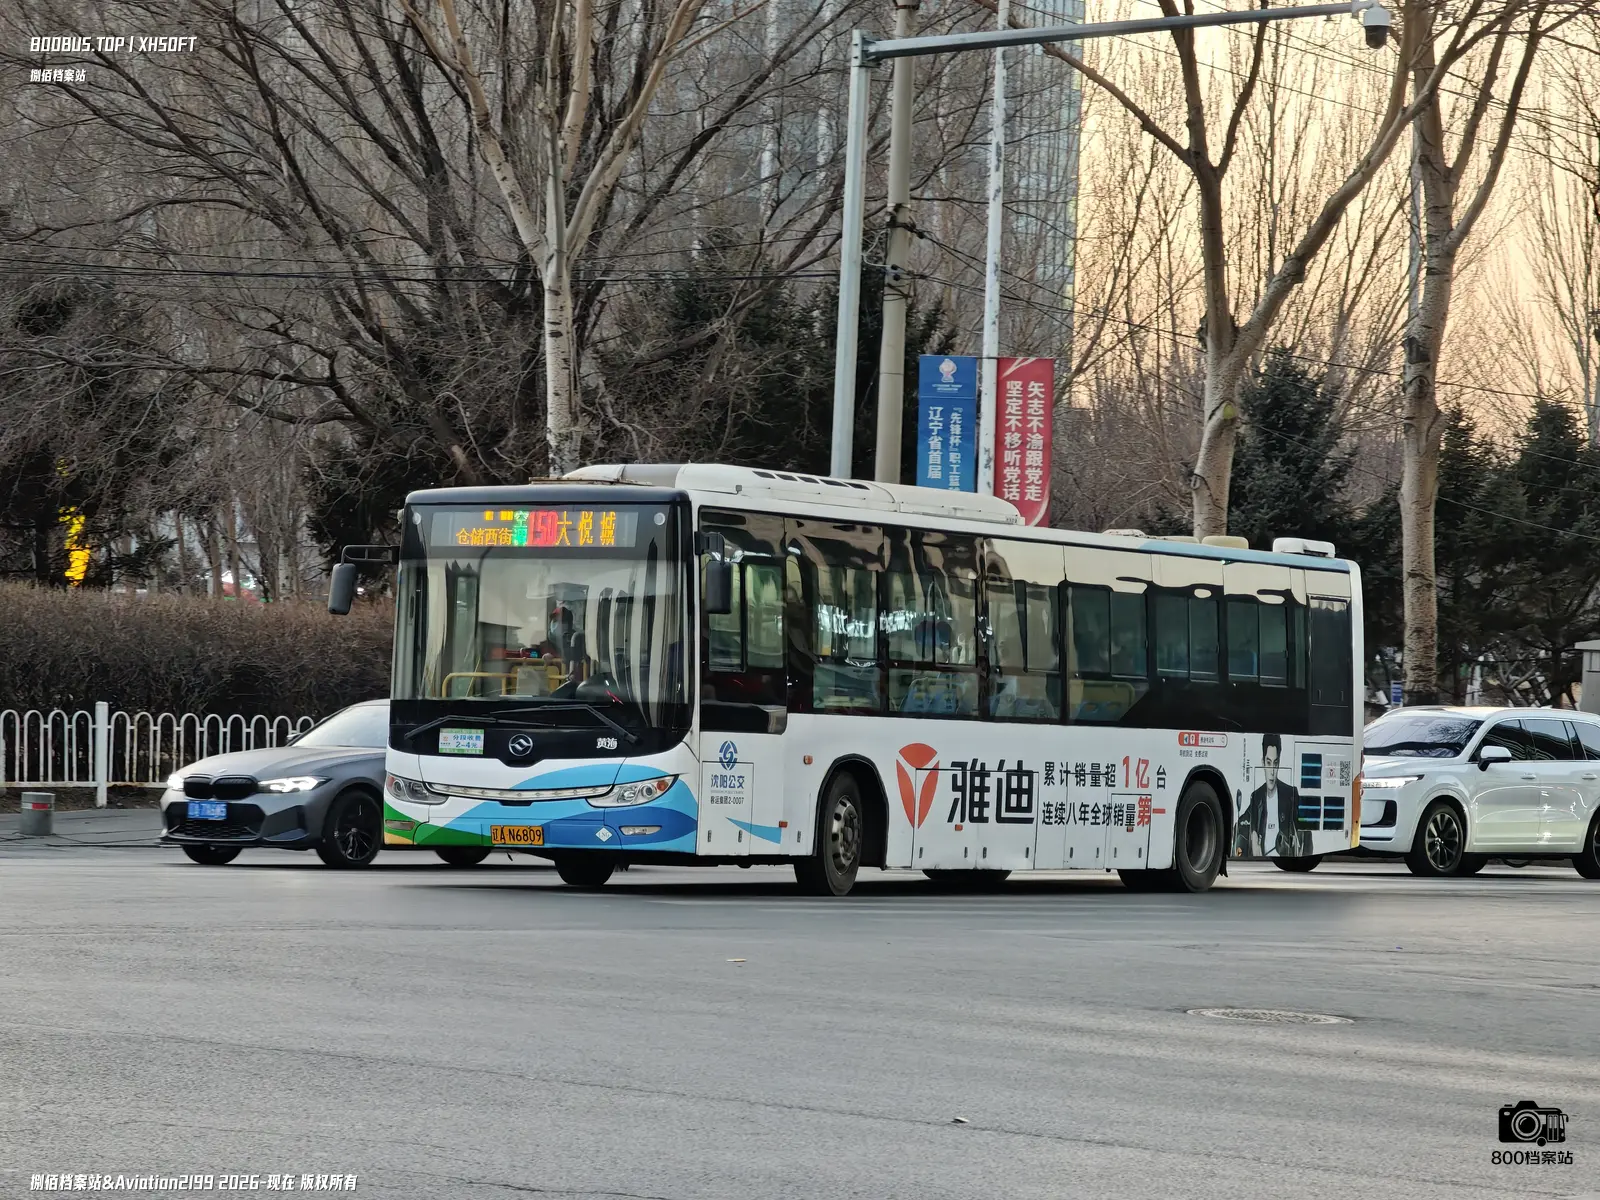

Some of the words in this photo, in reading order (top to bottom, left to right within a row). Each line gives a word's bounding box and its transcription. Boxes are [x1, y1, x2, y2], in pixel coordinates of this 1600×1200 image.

[927, 406, 944, 480] 辽宁省首届
[1002, 380, 1023, 502] 坚定不移听党话
[1024, 380, 1045, 502] 矢志不渝跟党走
[456, 527, 513, 546] 仓储西街
[529, 511, 558, 546] 150
[453, 734, 481, 742] 分段收费
[596, 737, 618, 750] 黄海
[710, 774, 745, 789] 沈阳公交
[947, 758, 1035, 824] 雅迪
[1041, 796, 1166, 827] 连续八年全球销量第一
